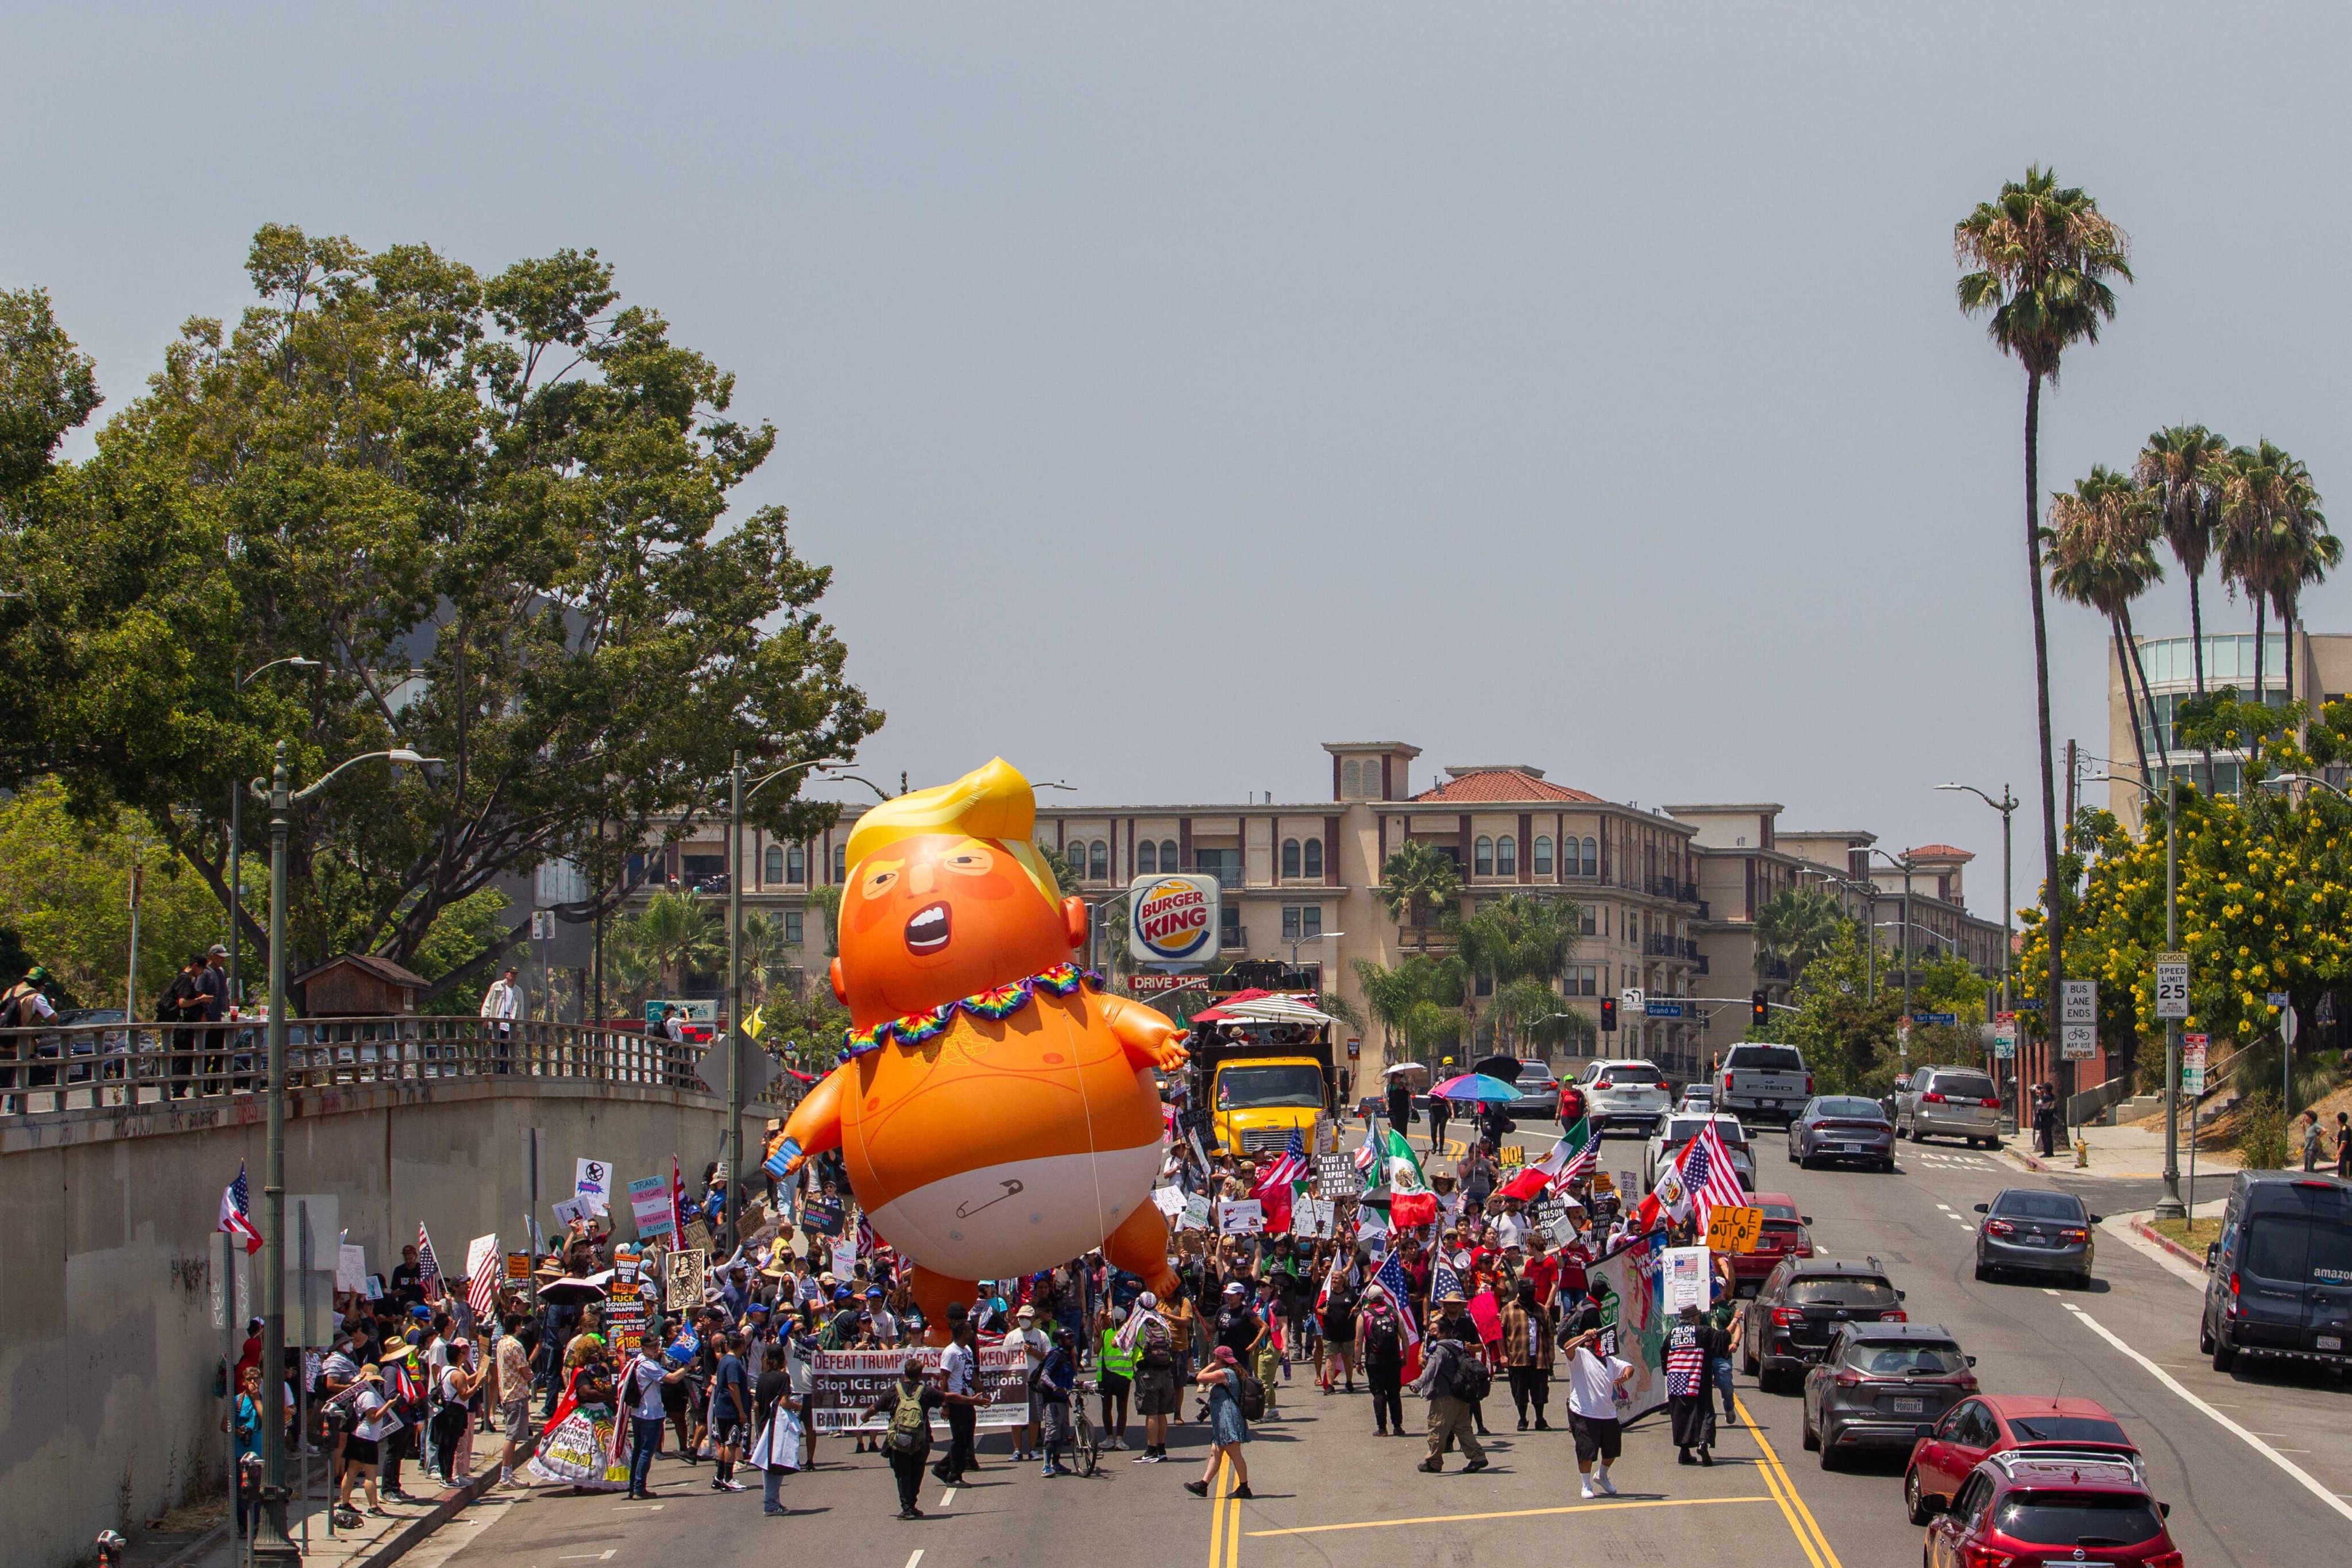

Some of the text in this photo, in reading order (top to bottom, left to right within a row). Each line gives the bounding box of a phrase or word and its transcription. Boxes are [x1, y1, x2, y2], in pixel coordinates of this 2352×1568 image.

[1142, 891, 1203, 919] BURGER
[1144, 907, 1207, 942] KING
[1134, 978, 1173, 988] DRIVE
[2070, 985, 2087, 993] BUS
[2160, 984, 2185, 999] 25
[2067, 997, 2090, 1005] LANE
[2068, 1009, 2090, 1017] ENDS
[1322, 1156, 1339, 1164] ELECT
[1500, 1146, 1522, 1164] NO!
[1319, 1163, 1351, 1171] RAPIST
[1324, 1171, 1346, 1179] EXPECT
[634, 1178, 658, 1191] TRANS
[639, 1189, 662, 1200] RIGHTS
[1320, 1186, 1353, 1195] FUCKED
[1538, 1198, 1563, 1211] NO POSH
[642, 1214, 666, 1224] HUMAN
[805, 1214, 821, 1223] DEPORT
[1539, 1208, 1565, 1221] PRISON
[1717, 1206, 1758, 1225] ICE
[647, 1222, 671, 1233] RIGHTS
[1540, 1219, 1554, 1229] FOR
[1710, 1223, 1756, 1240] OUT OF
[1721, 1236, 1739, 1250] LA
[616, 1260, 638, 1268] TRUMP
[618, 1268, 636, 1276] MUST
[2314, 1268, 2352, 1280] amazo
[622, 1275, 631, 1283] GO
[1671, 1326, 1695, 1334] FELON
[1670, 1337, 1696, 1346] FELON
[814, 1354, 858, 1370] DEFEAT
[817, 1378, 871, 1394] Stop ICE
[840, 1392, 856, 1407] by
[569, 1416, 590, 1431] FUCK
[817, 1412, 857, 1427] BAMN
